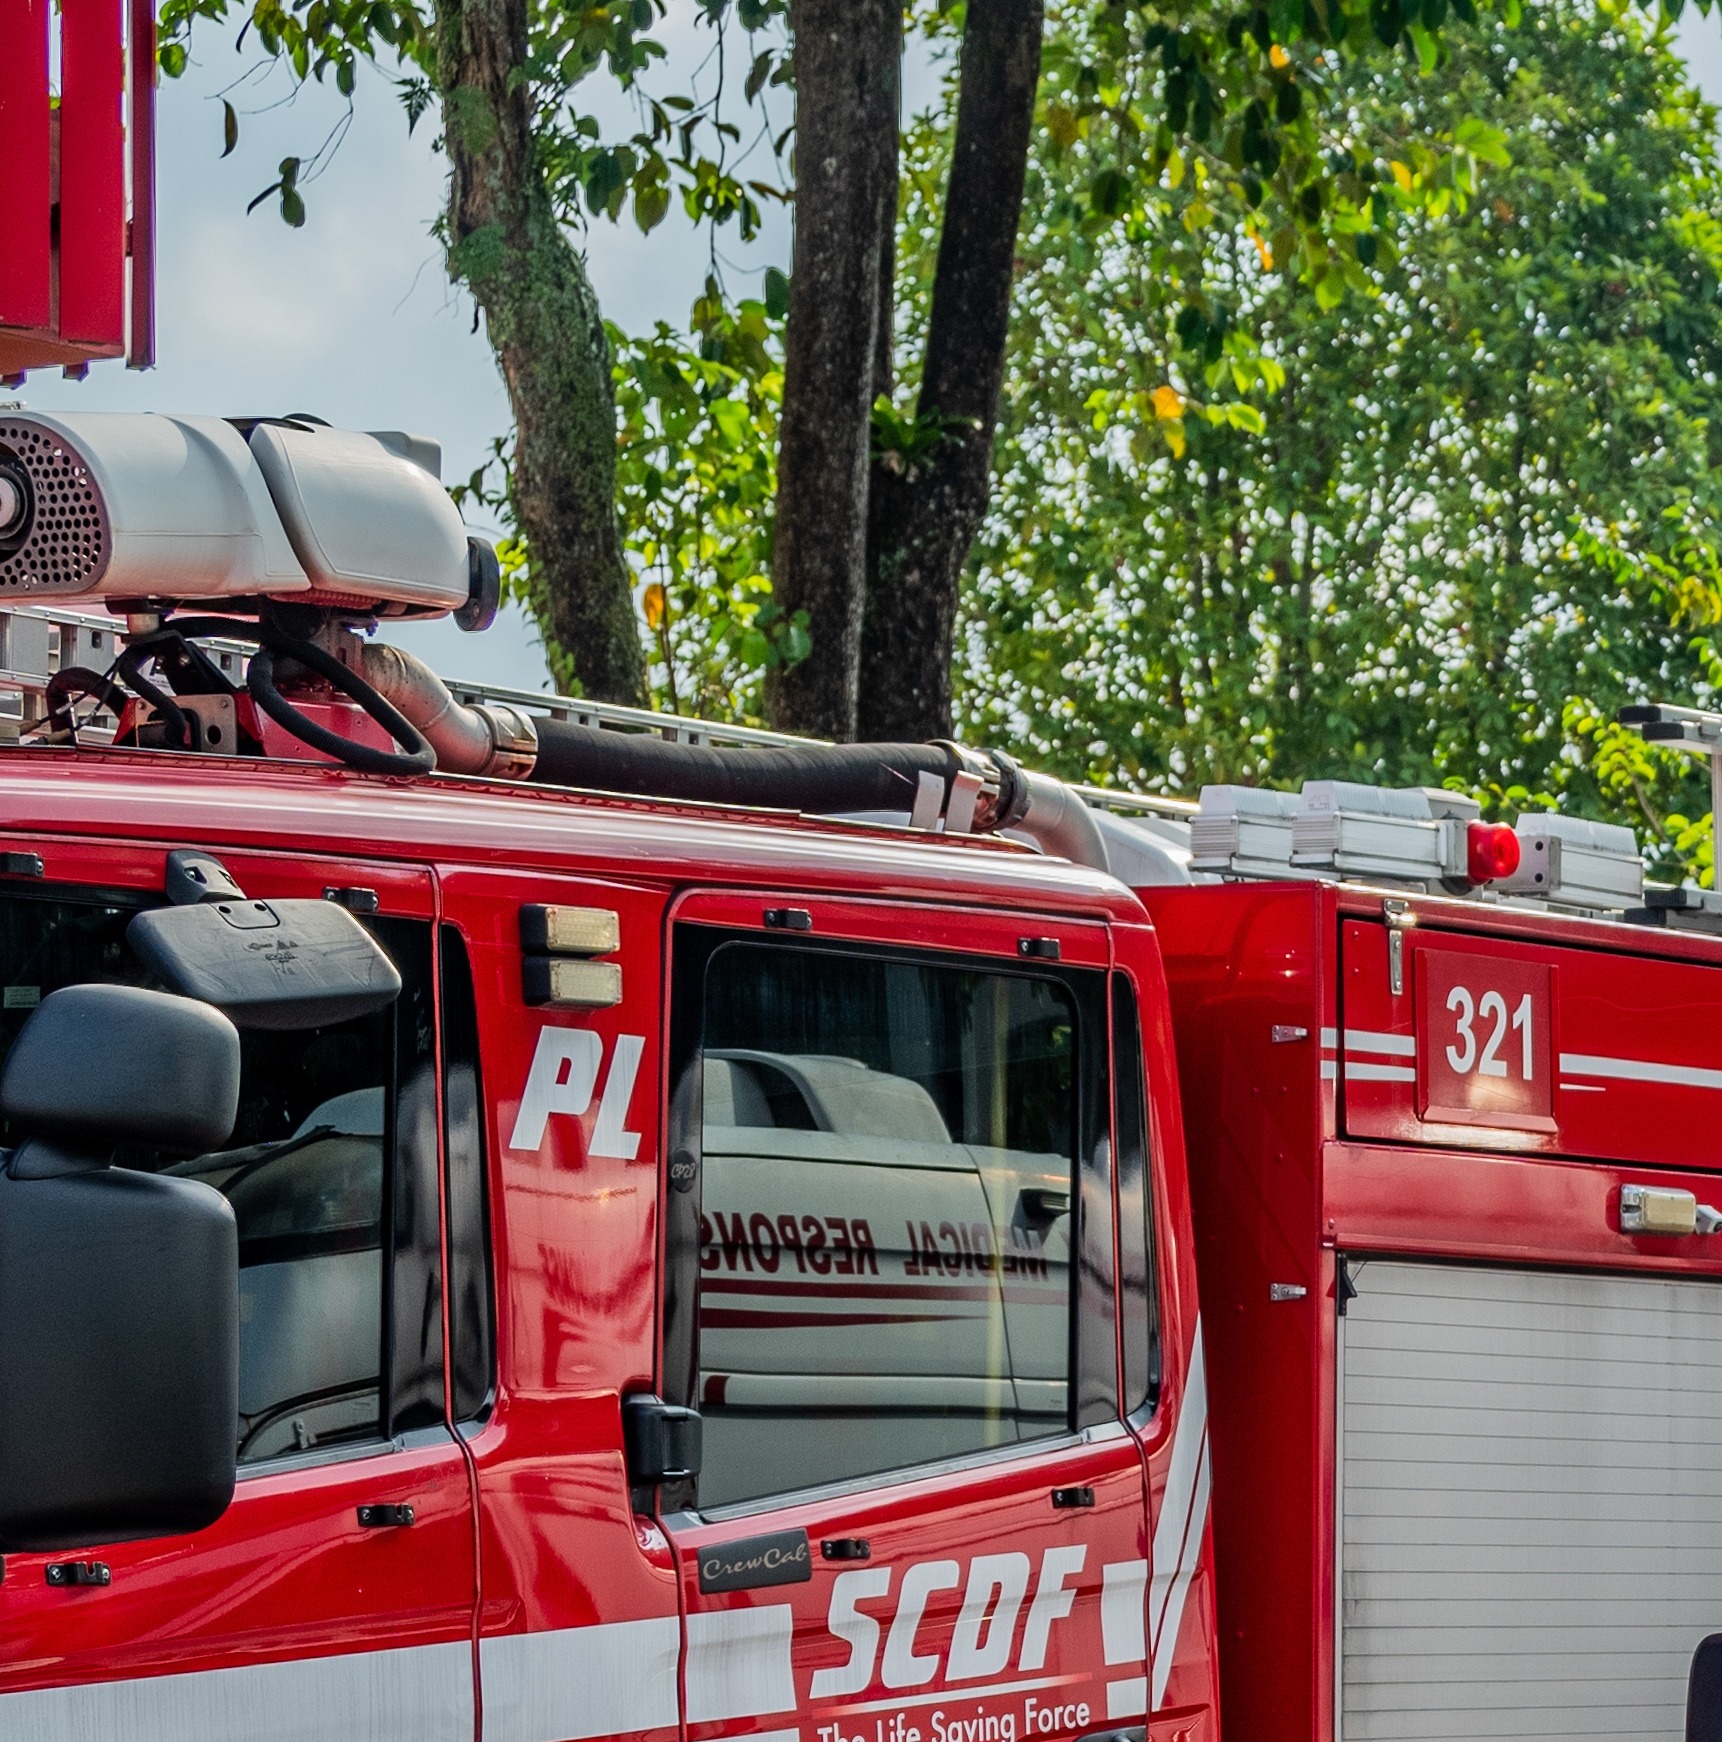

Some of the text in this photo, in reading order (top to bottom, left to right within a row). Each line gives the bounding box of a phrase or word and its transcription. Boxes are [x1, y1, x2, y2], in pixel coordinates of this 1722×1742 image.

[1445, 985, 1534, 1081] 321
[508, 1024, 647, 1161] PL
[702, 1541, 808, 1582] CrewCab
[808, 1543, 1088, 1700] SCDF
[1024, 1697, 1091, 1736] Force
